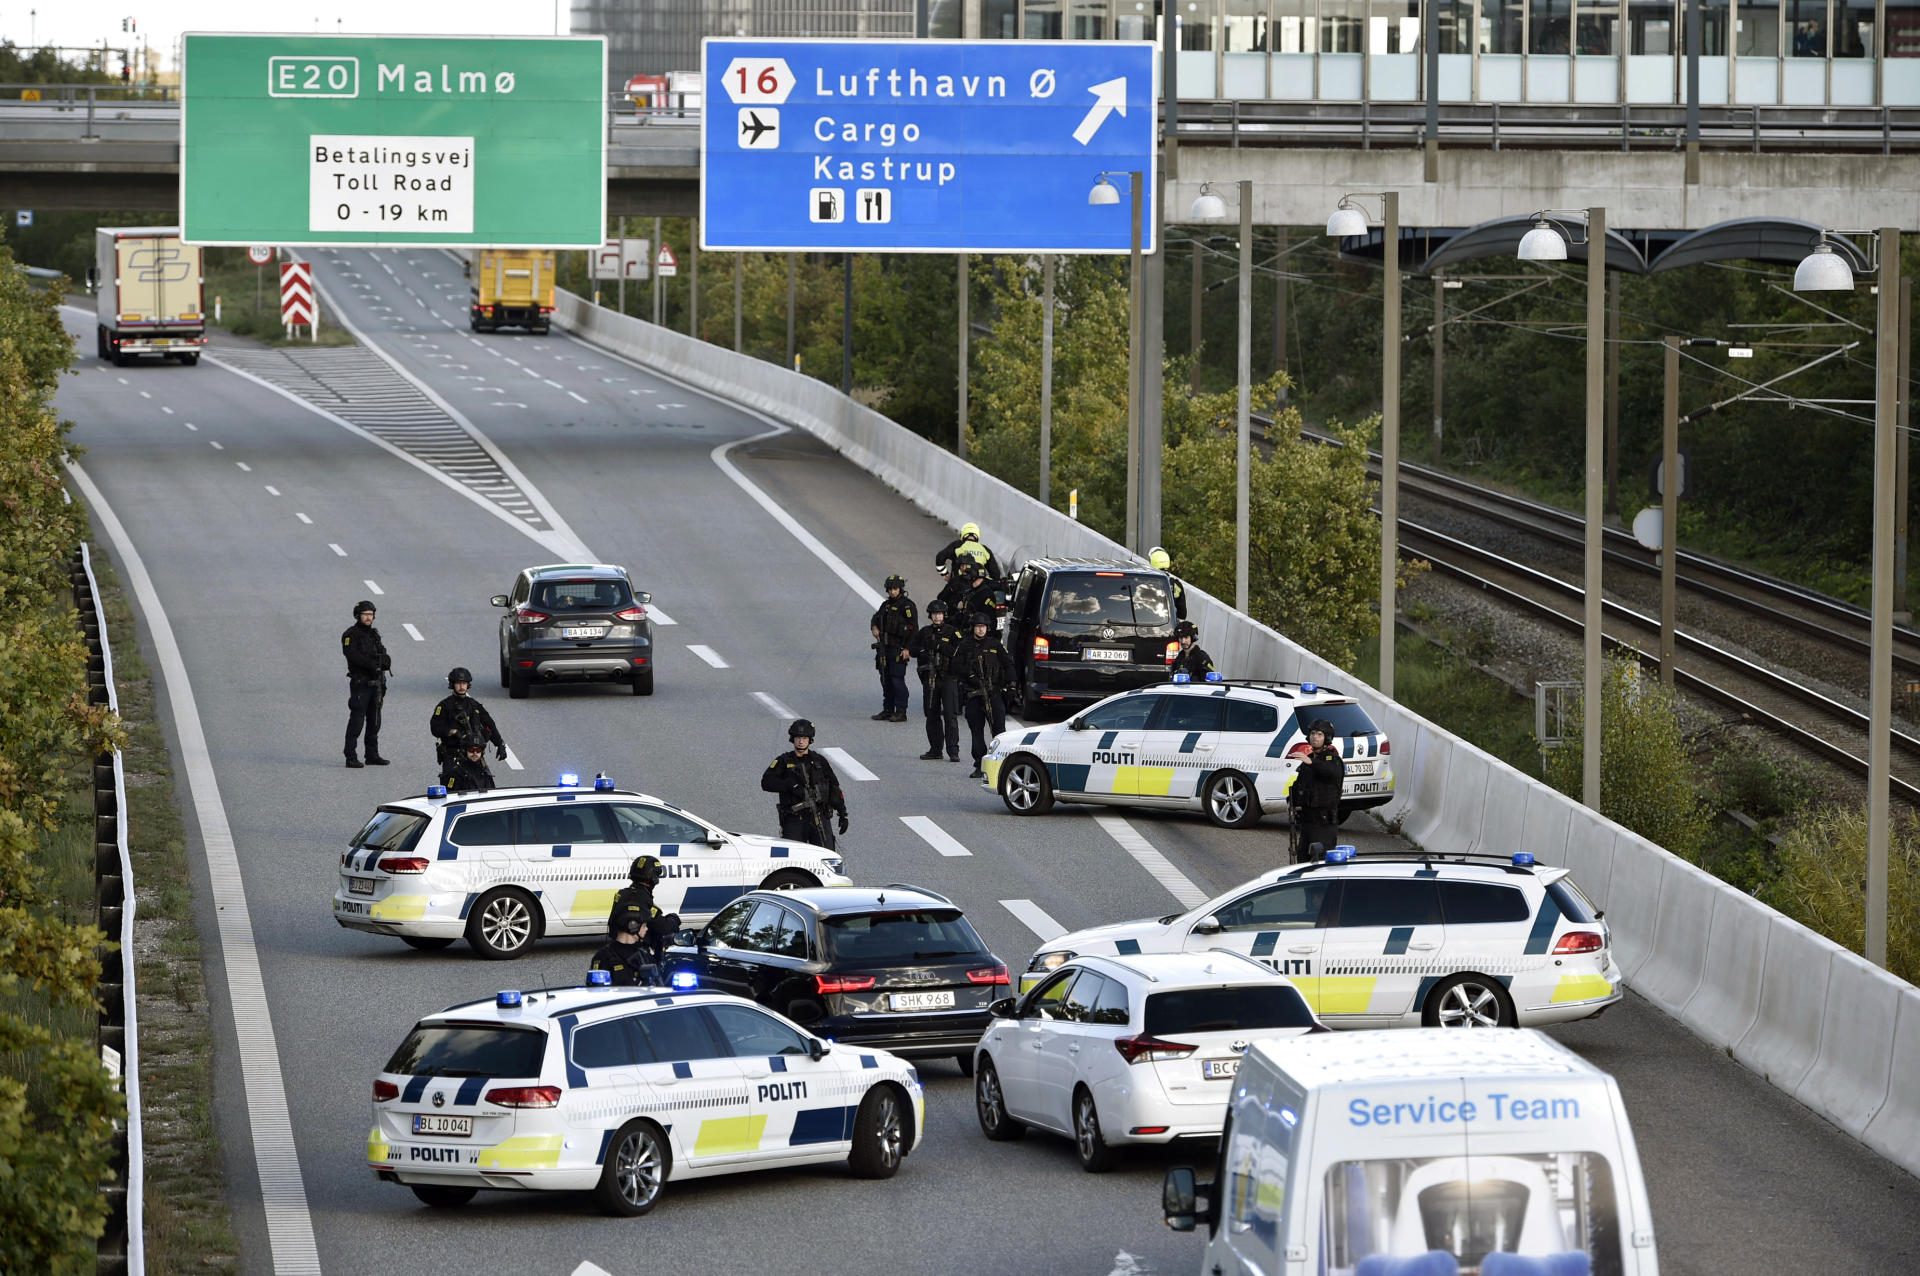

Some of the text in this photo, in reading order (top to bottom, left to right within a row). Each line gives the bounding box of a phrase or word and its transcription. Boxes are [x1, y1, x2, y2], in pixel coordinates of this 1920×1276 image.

[280, 64, 516, 93] E20 Malmø
[736, 66, 778, 95] 16
[816, 67, 1056, 98] Lufthavn Ø
[814, 116, 921, 147] Cargo
[315, 146, 469, 168] Betalingsvej
[814, 155, 956, 185] Kastrup
[333, 173, 451, 191] Toll Road
[337, 203, 351, 221] 0
[379, 204, 402, 221] 19
[418, 204, 448, 221] km
[1092, 650, 1128, 660] AR 32 069
[1092, 751, 1135, 765] POLITI
[1354, 783, 1379, 793] POLITI
[659, 864, 699, 879] OLITI
[342, 901, 363, 914] POLITI
[1259, 960, 1311, 975] LITI
[900, 993, 950, 1006] SHK 968
[1213, 1063, 1230, 1074] BC
[757, 1081, 807, 1103] POLITI
[1349, 1094, 1580, 1126] Service Team
[420, 1118, 468, 1132] BL 10 041
[410, 1147, 460, 1163] POLITI
